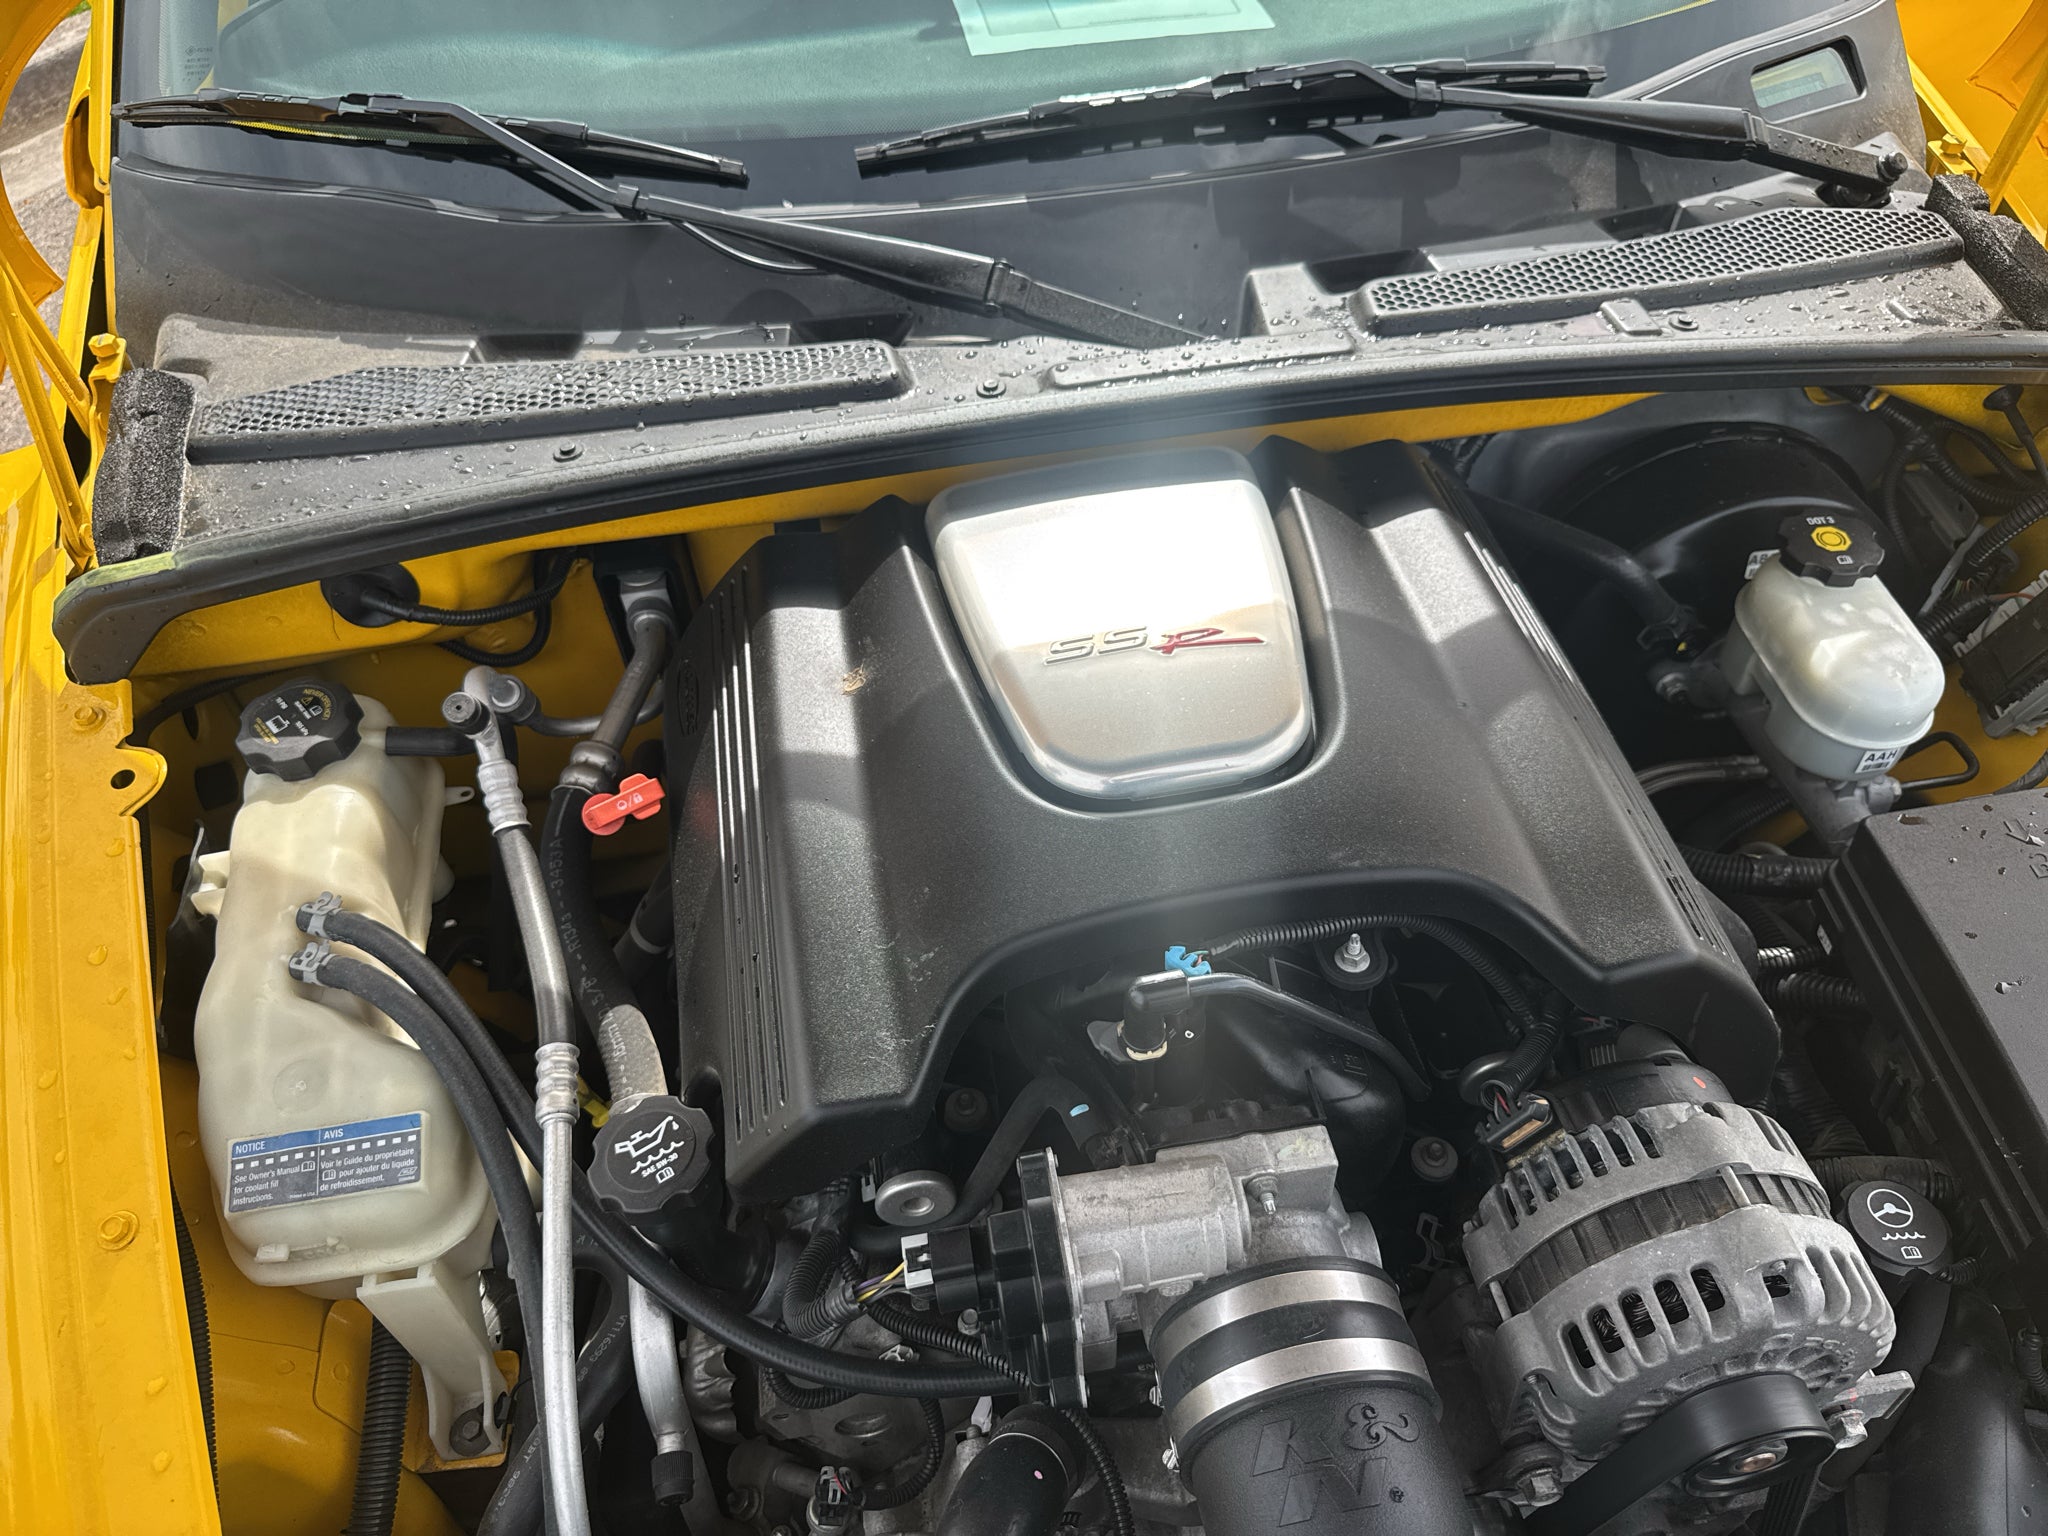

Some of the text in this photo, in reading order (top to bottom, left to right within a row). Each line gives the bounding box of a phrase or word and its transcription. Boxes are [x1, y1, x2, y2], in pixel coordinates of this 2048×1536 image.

[806, 516, 835, 526] DOT 3
[1865, 749, 1898, 762] AAH
[323, 1128, 344, 1140] AVIS
[235, 1140, 266, 1154] NOTICE
[320, 1148, 415, 1170] Voir le Guide du propriétaire
[234, 1165, 300, 1184] See Owner's Manual
[338, 1158, 415, 1180] pour ajouter du liquide
[641, 1164, 657, 1178] SAE
[234, 1180, 279, 1195] for coolant fill
[319, 1175, 385, 1192] de refroidissement.
[233, 1193, 274, 1206] instructions.
